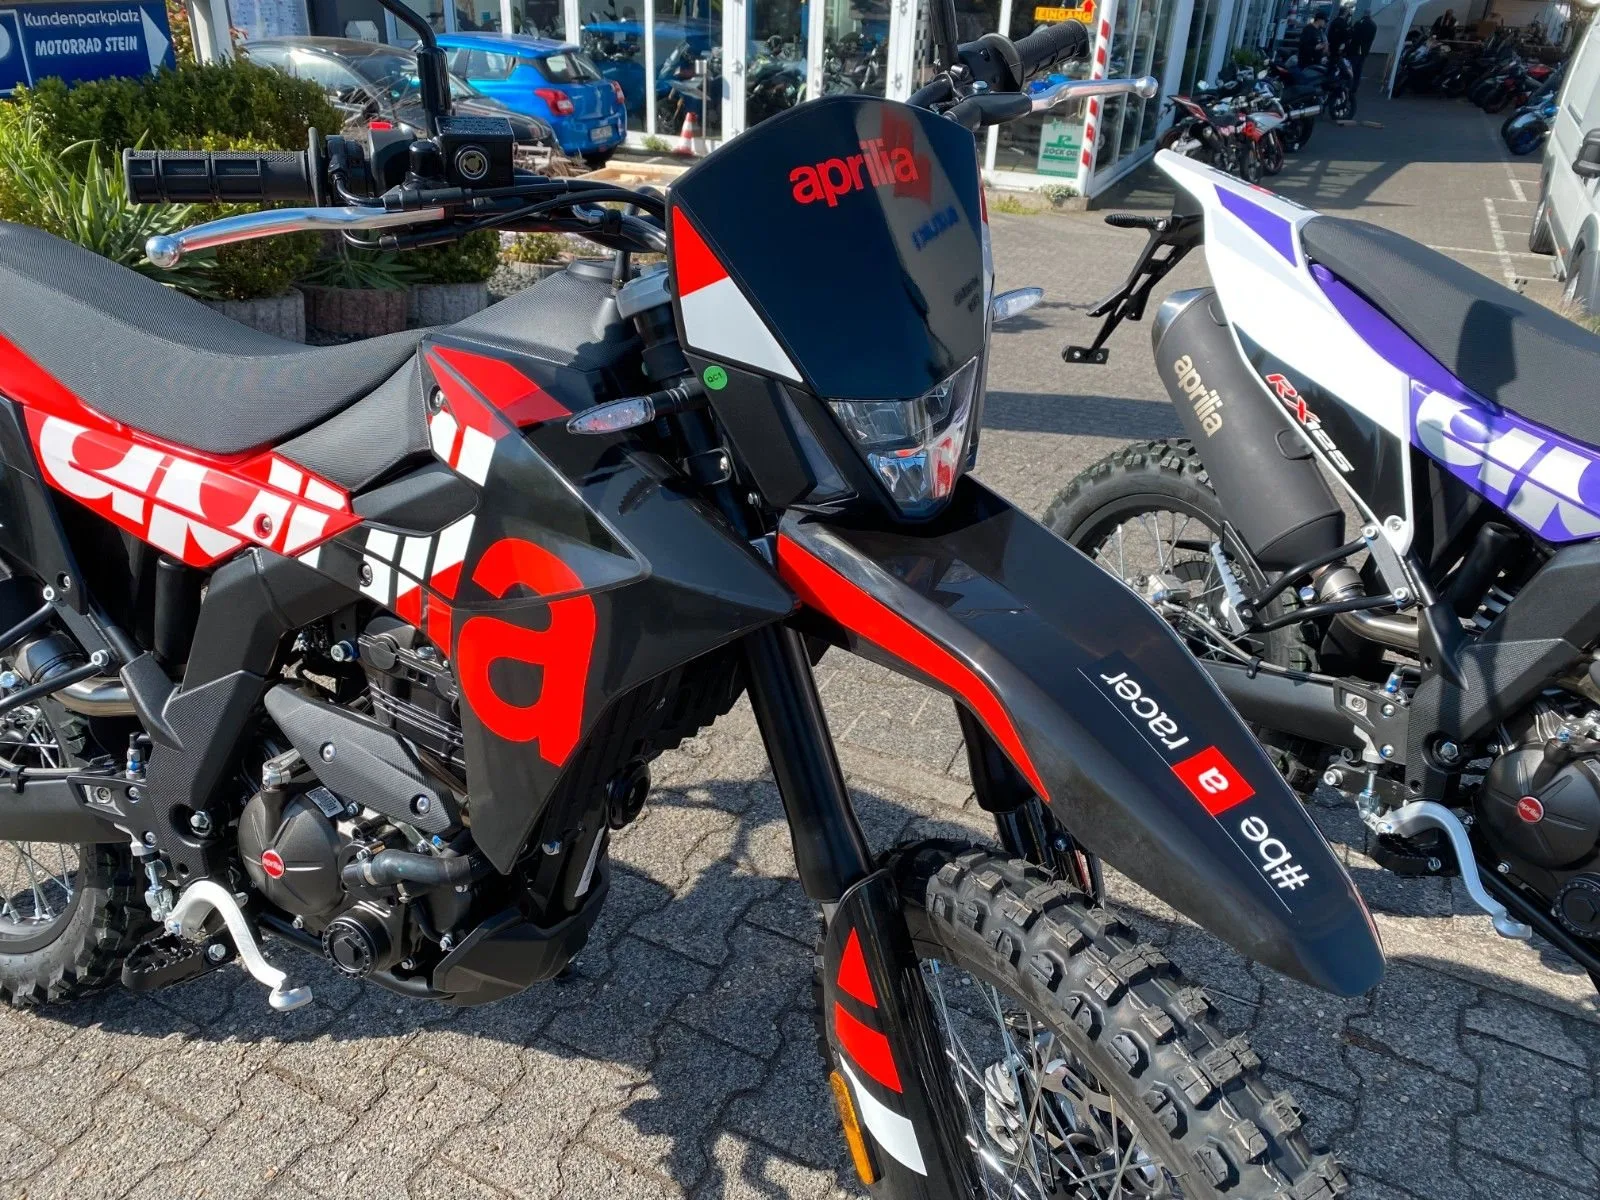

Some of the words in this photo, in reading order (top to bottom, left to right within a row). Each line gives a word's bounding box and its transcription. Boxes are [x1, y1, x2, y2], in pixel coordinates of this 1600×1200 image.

[24, 10, 140, 27] Kundenparkplatz
[1038, 10, 1091, 21] EINGANG
[35, 38, 102, 56] MOTORRAD
[105, 36, 138, 52] STEIN
[789, 138, 919, 207] aprilia
[1174, 354, 1223, 438] aprilia
[1099, 671, 1190, 750] racer
[1197, 766, 1230, 795] a
[1240, 815, 1310, 891] #be
